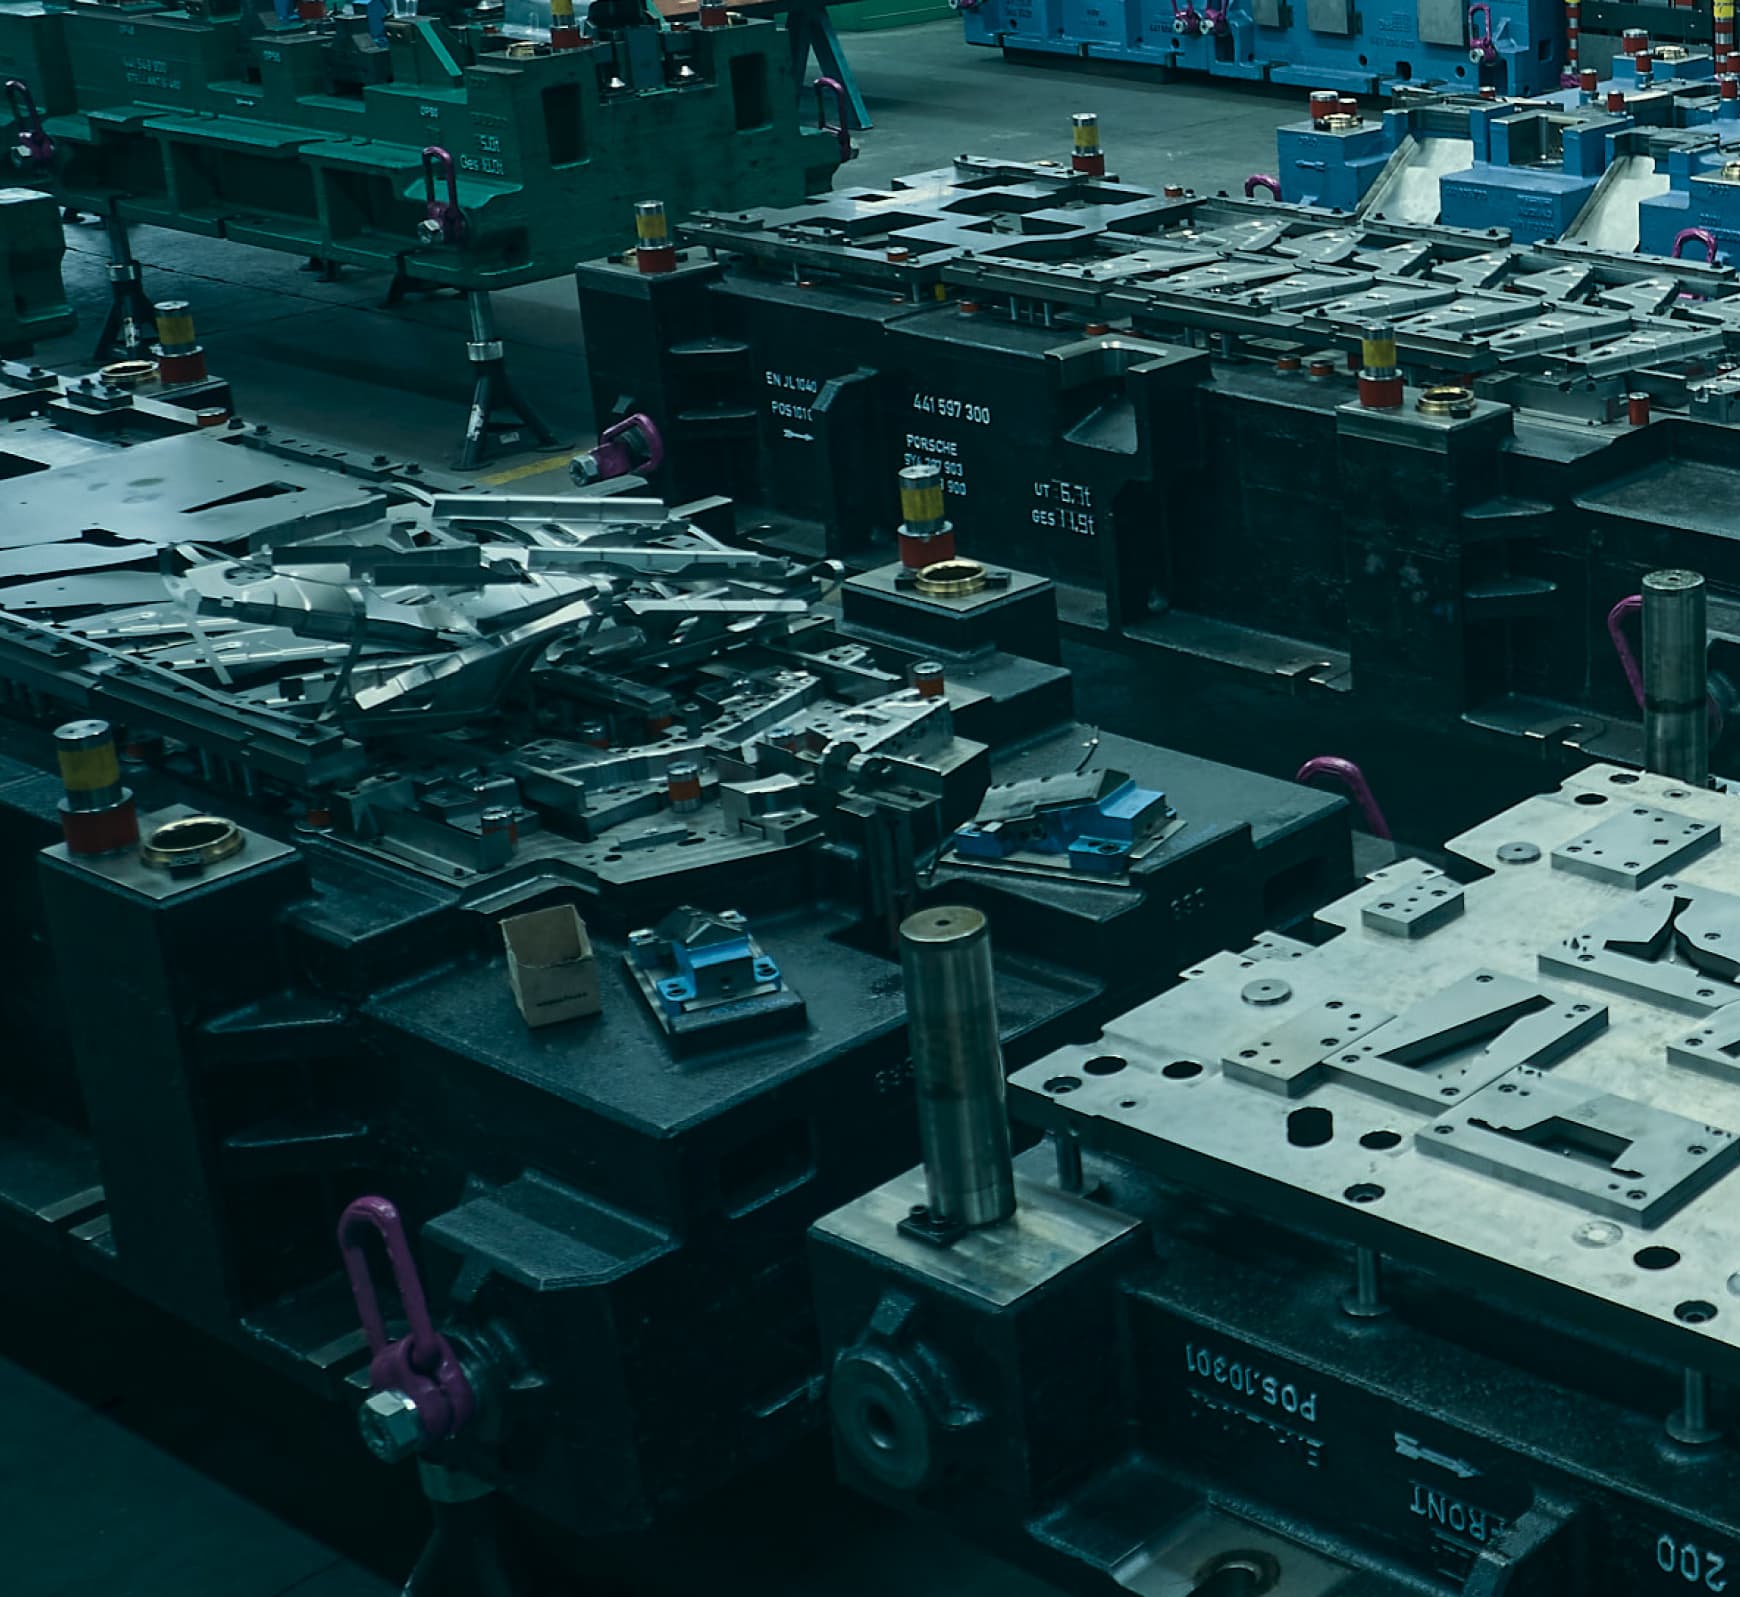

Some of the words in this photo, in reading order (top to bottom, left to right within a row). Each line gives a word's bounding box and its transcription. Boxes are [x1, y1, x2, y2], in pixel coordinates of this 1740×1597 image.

[765, 370, 782, 387] EN
[913, 392, 935, 414] 441
[937, 398, 962, 418] 597
[965, 403, 991, 425] 300
[906, 434, 959, 457] PORSCHE
[944, 460, 964, 477] 903
[947, 479, 968, 496] 900
[1034, 481, 1050, 499] UT
[1031, 508, 1056, 528] GES
[1656, 1533, 1728, 1593] 200
